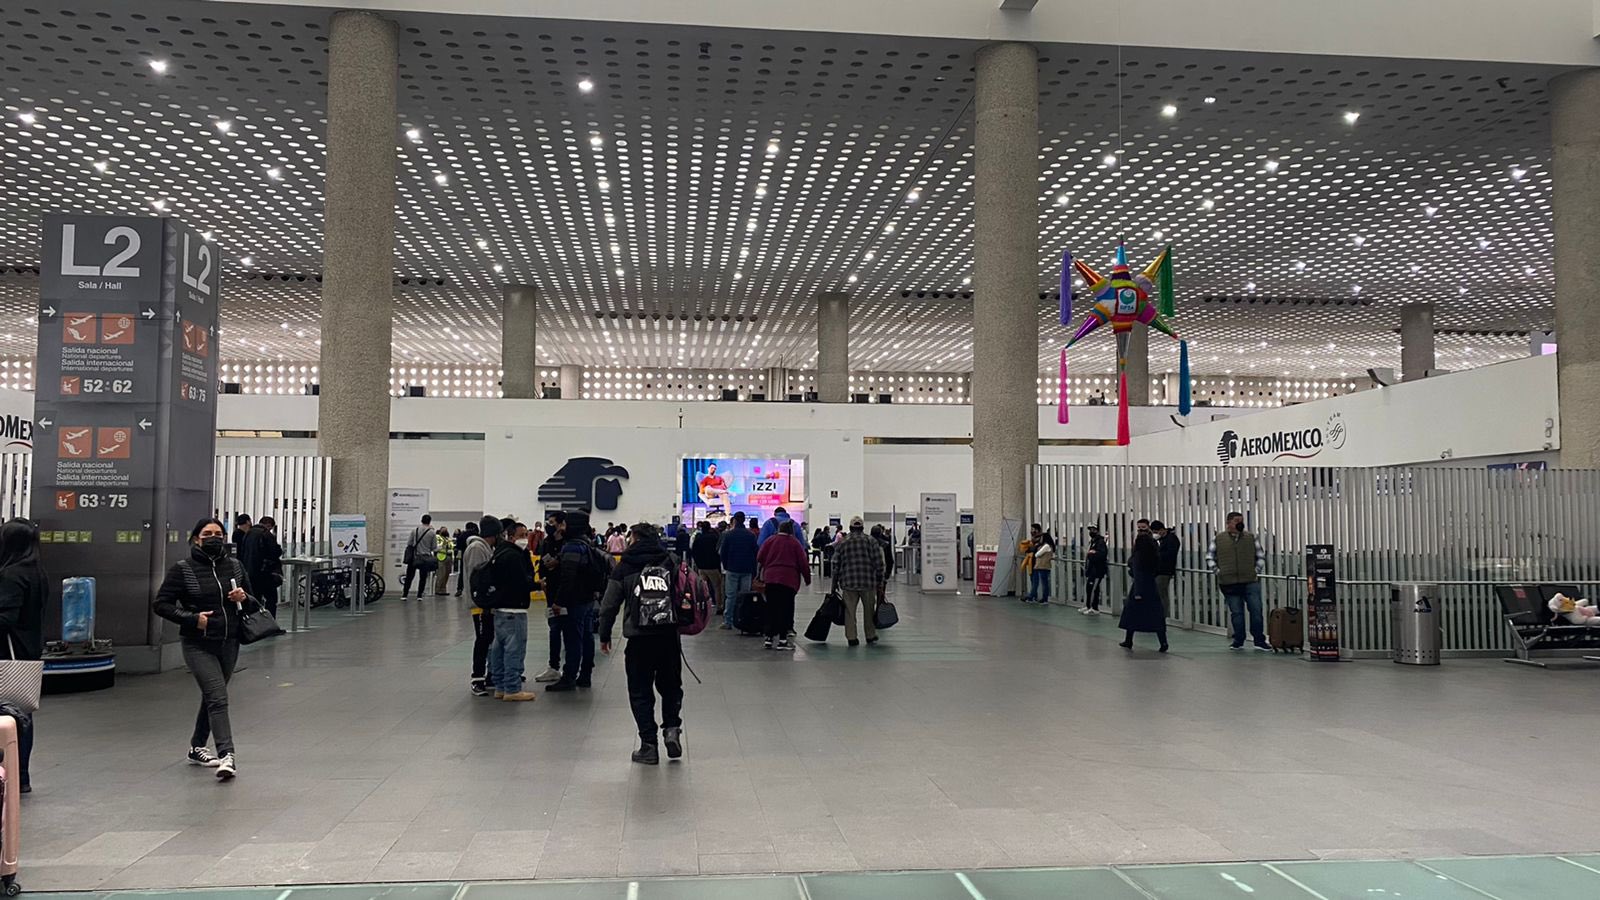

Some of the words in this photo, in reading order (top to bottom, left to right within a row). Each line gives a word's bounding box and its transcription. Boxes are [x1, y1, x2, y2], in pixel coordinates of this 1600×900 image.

[61, 224, 141, 277] L2
[182, 232, 211, 295] L2
[78, 281, 97, 289] Sala
[105, 282, 122, 290] Hall
[86, 359, 134, 367] internacional
[640, 575, 668, 592] VANS
